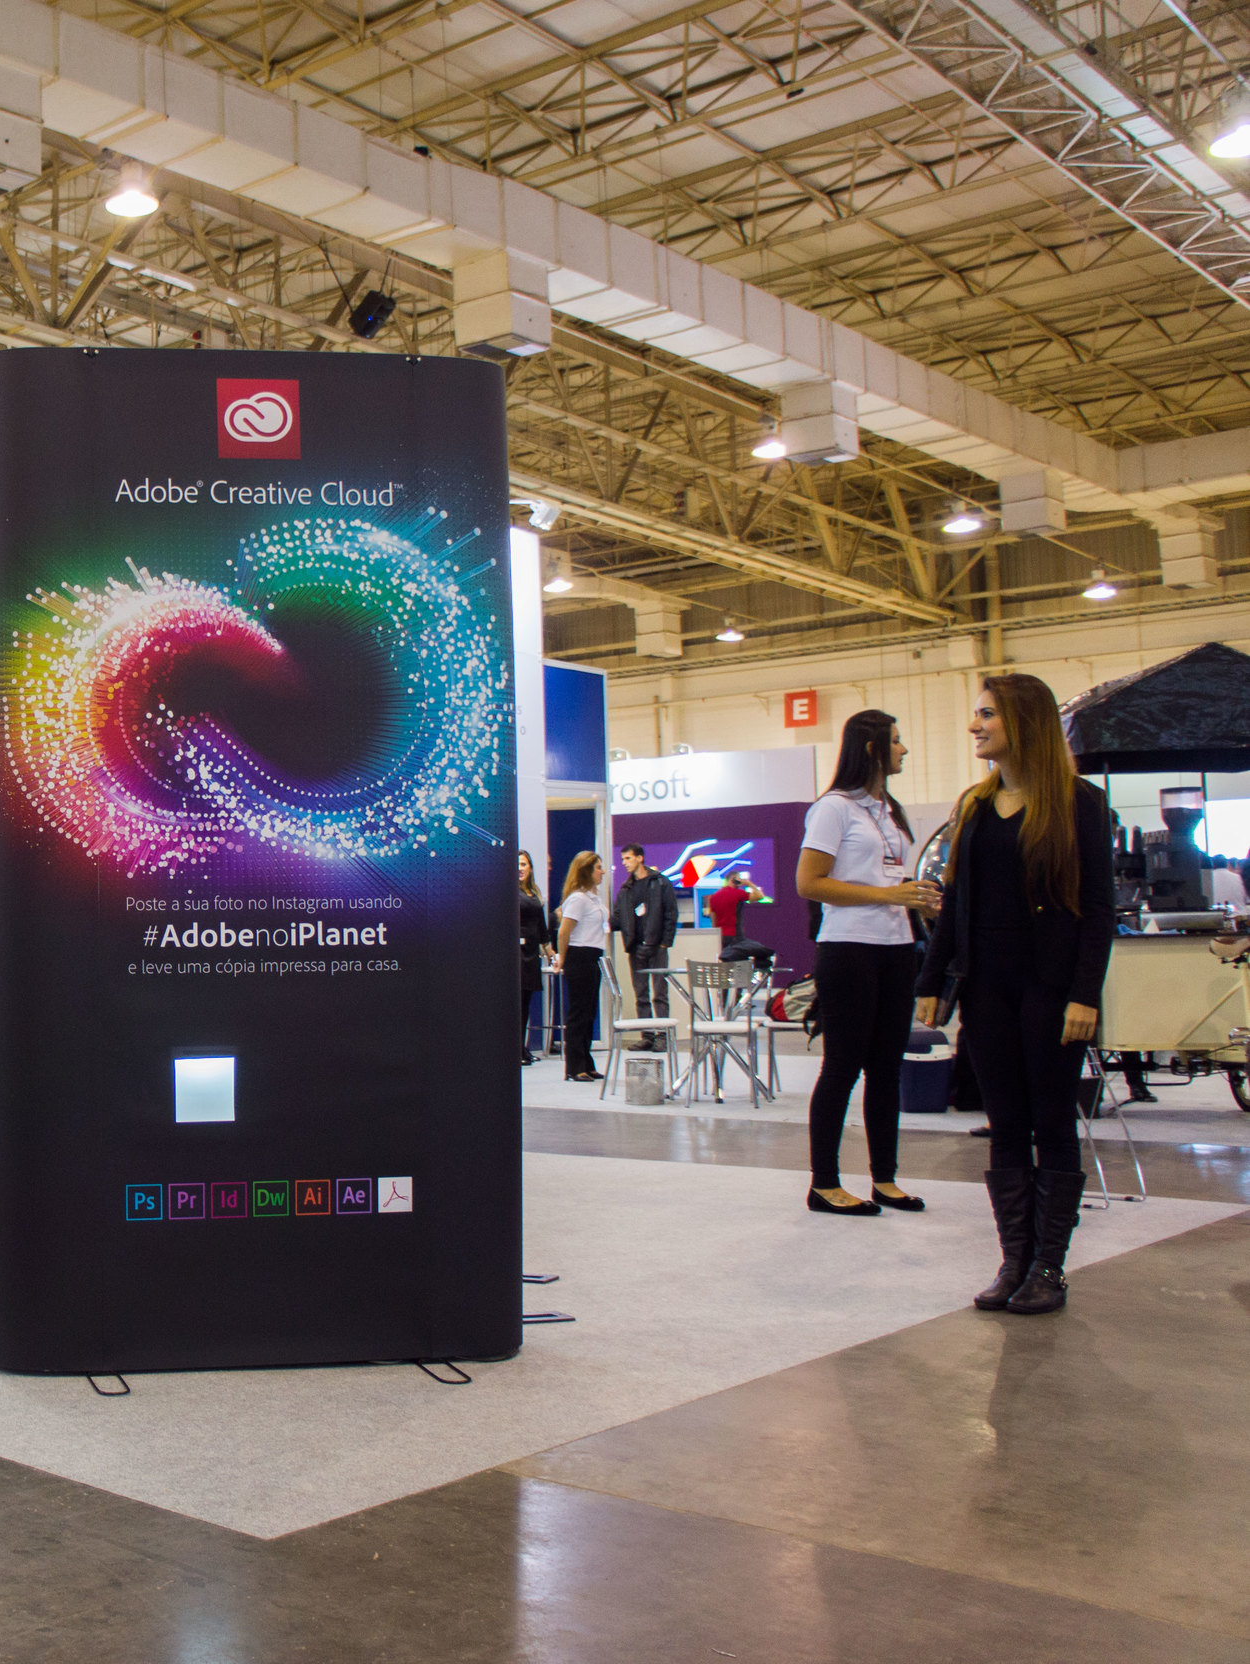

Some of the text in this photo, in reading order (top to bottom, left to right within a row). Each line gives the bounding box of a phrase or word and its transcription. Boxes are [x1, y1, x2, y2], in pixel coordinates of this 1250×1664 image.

[210, 480, 312, 505] Creative
[792, 698, 809, 720] E
[126, 894, 402, 914] Poste a sua foto no Instagram usando
[143, 921, 387, 947] #AdobenoiPlanet
[128, 958, 402, 977] e leve uma cópia impressa para casa.
[134, 1186, 366, 1210] Ps Pr Id Dw Ai Ae
